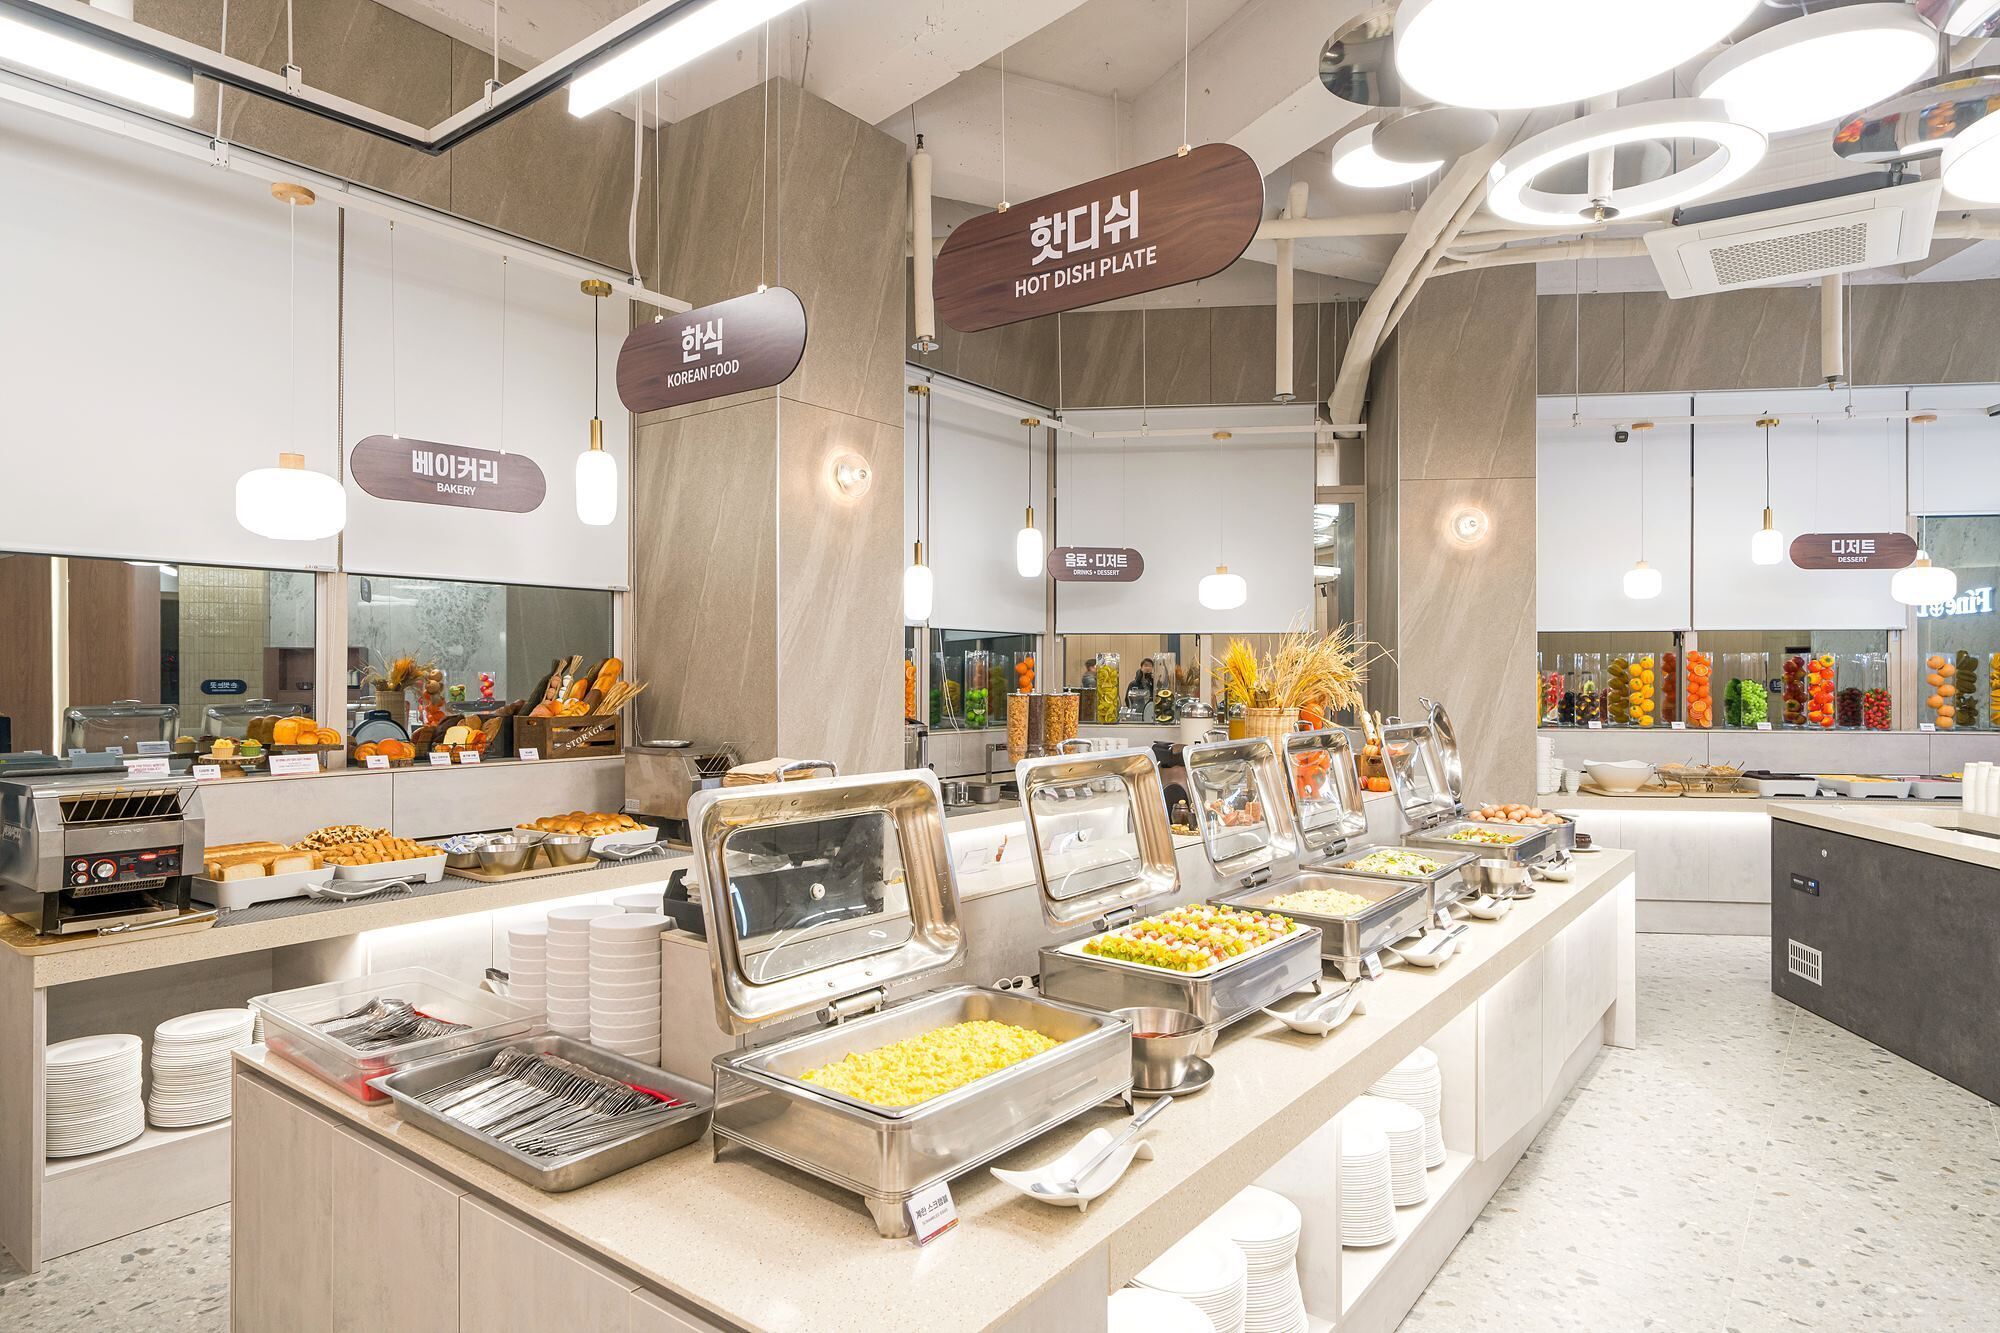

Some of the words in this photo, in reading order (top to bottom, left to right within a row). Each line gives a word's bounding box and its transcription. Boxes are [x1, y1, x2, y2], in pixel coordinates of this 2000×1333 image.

[1029, 188, 1139, 267] 핫디쉬
[1015, 273, 1051, 298] HOT
[1054, 261, 1095, 289] DISH
[1100, 245, 1157, 277] PLATE
[681, 317, 723, 364] 한식
[667, 366, 708, 388] KOREAN
[710, 359, 740, 378] FOOD
[412, 450, 498, 485] 베이커리
[437, 482, 477, 496] BAKERY
[1065, 552, 1087, 567] 음료
[1095, 553, 1128, 568] 디저트
[1831, 539, 1876, 554] 디저트
[565, 724, 605, 750] STORAGE
